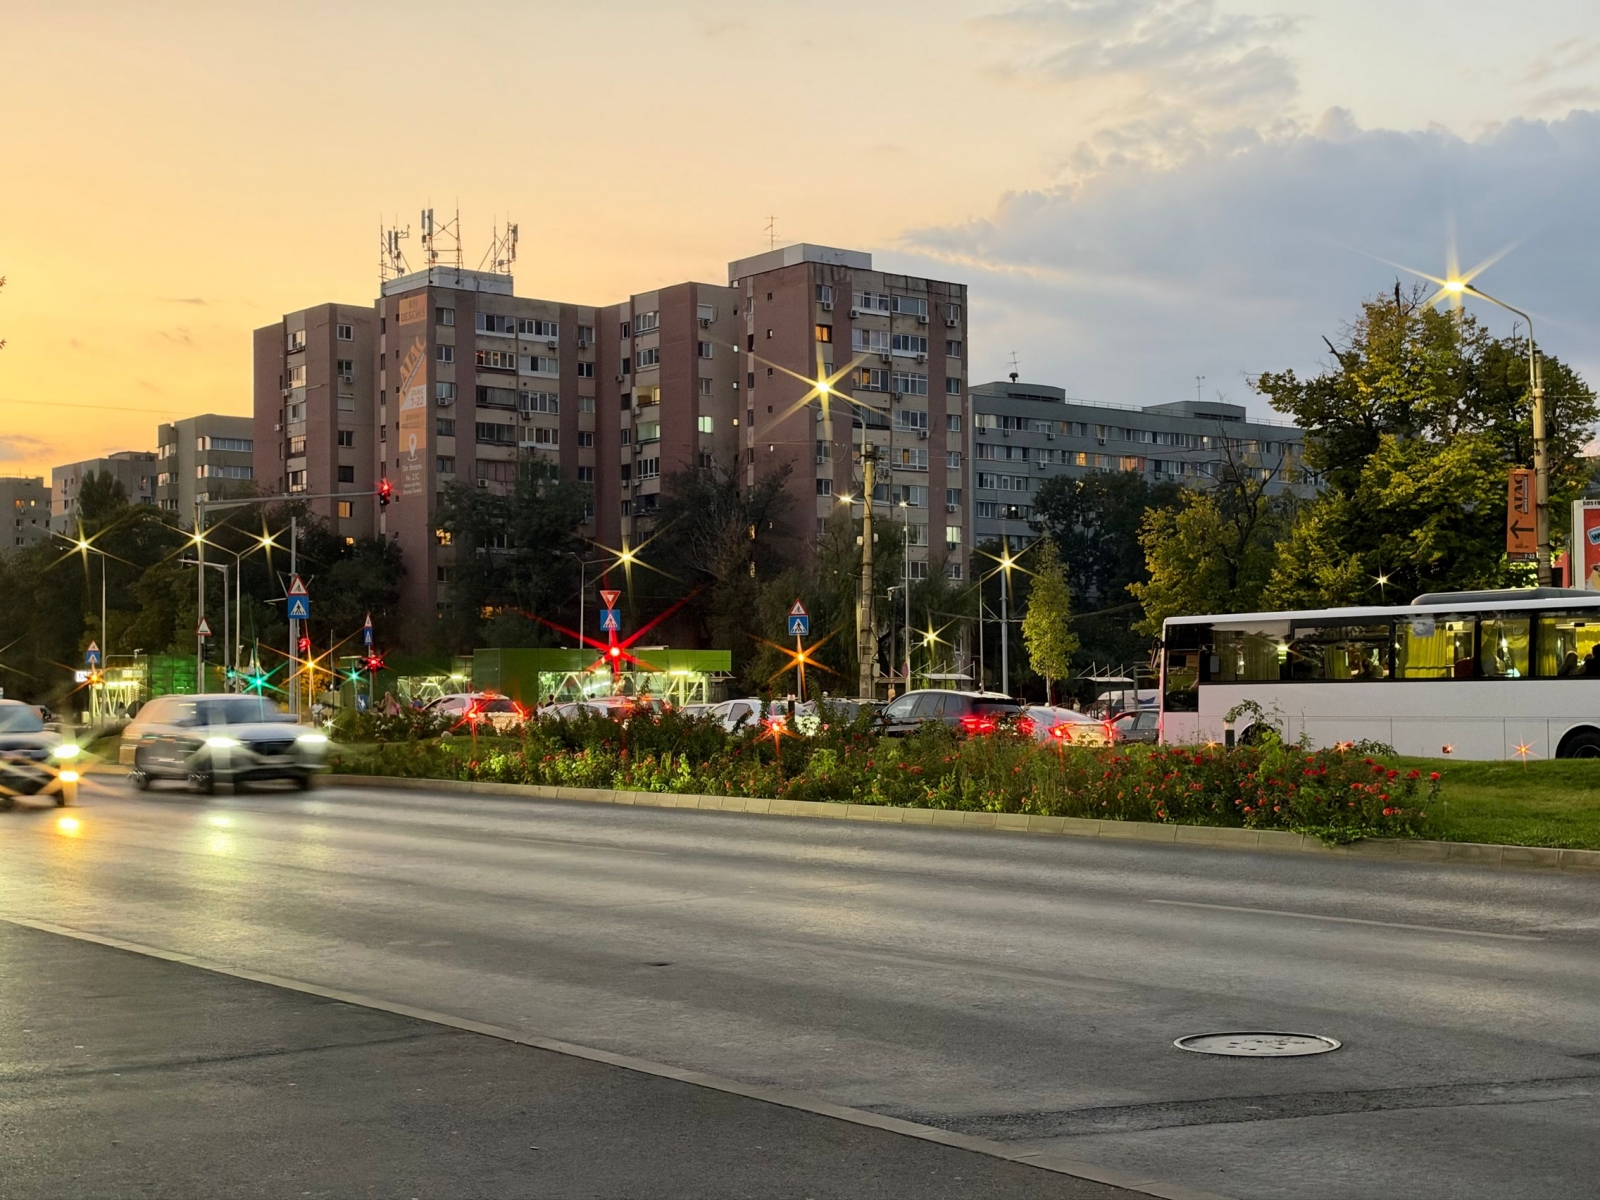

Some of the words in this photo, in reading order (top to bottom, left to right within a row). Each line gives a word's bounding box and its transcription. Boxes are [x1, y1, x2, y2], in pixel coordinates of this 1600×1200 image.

[401, 308, 425, 321] DESCHIS
[411, 396, 424, 407] 7-22
[1514, 474, 1523, 514] ATAC
